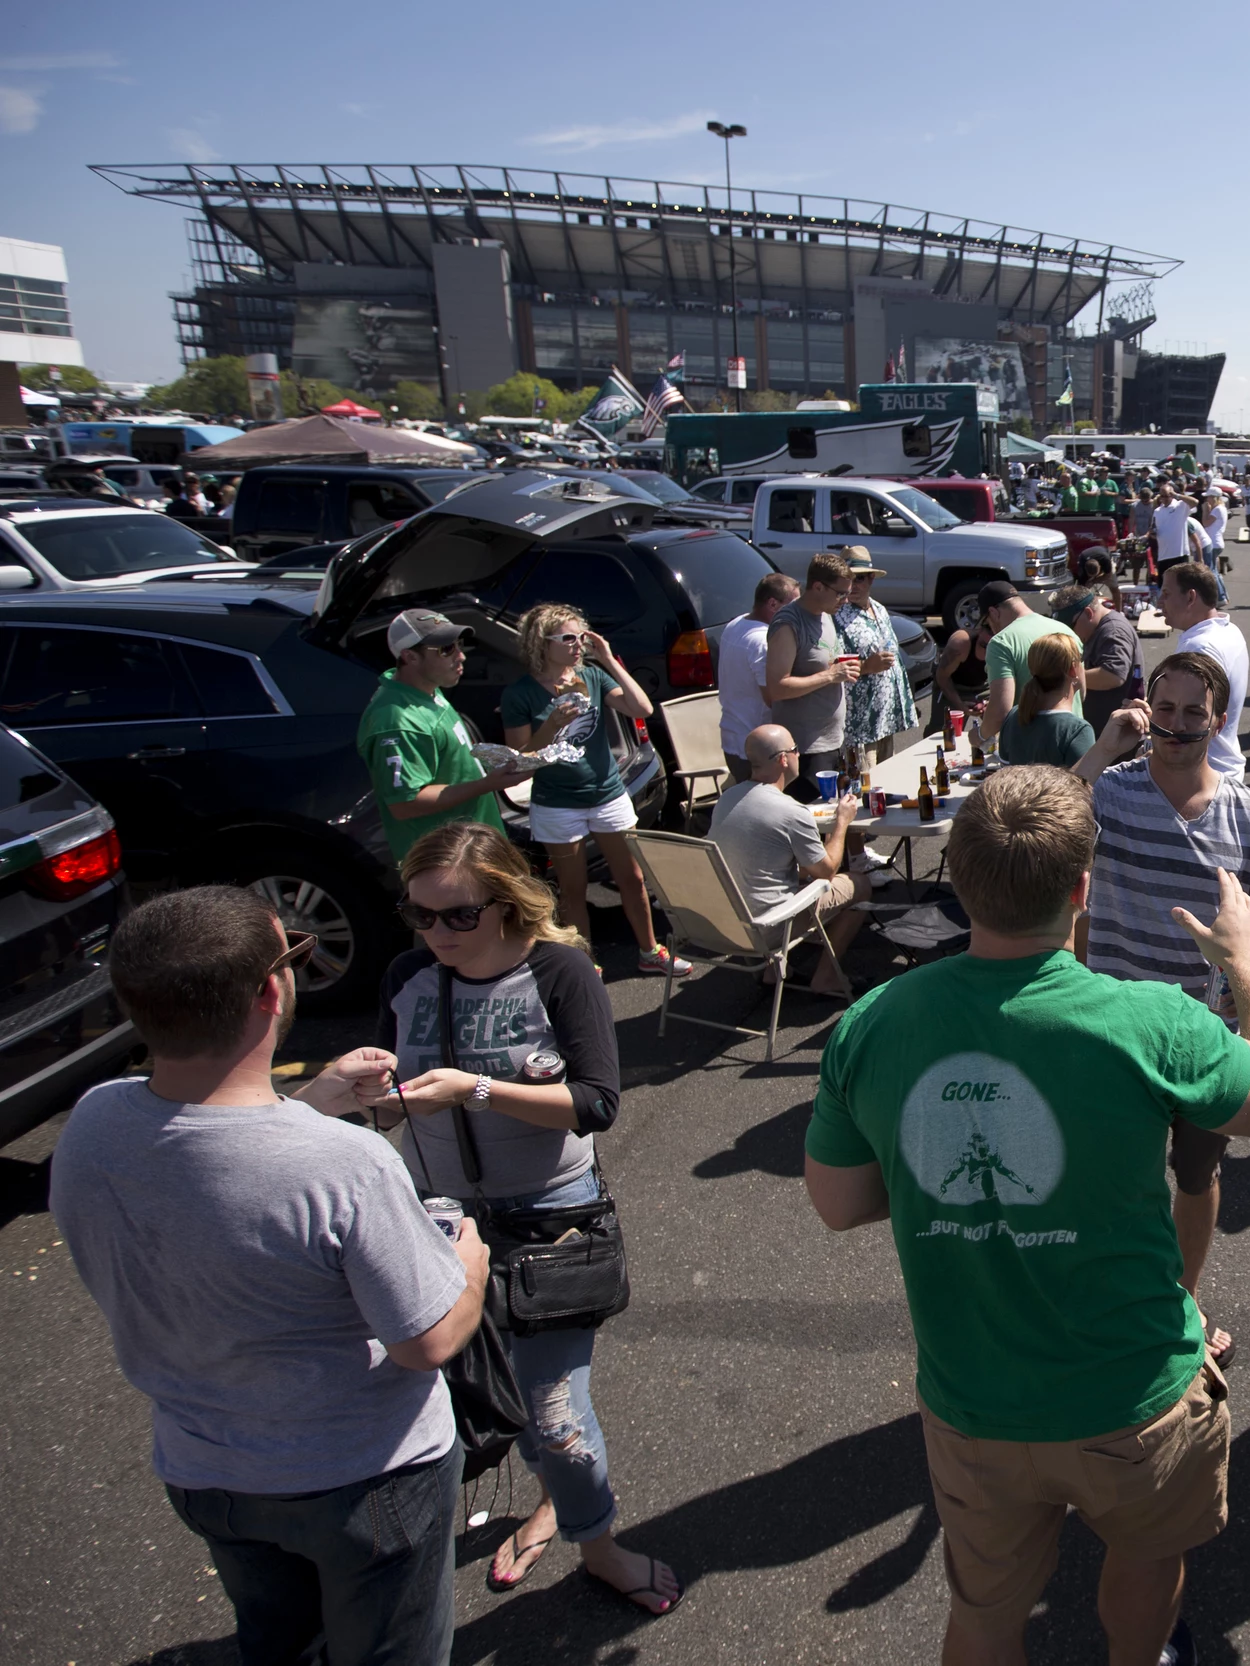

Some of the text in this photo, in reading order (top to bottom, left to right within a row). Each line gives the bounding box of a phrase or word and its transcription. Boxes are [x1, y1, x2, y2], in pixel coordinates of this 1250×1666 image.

[875, 391, 954, 412] EAGLES
[386, 755, 403, 787] 7
[415, 996, 527, 1015] PHADELPHIA
[406, 1012, 528, 1049] EAGLES
[941, 1081, 1011, 1102] GONE...
[916, 1220, 960, 1237] ...BUT
[963, 1222, 994, 1242] NOT
